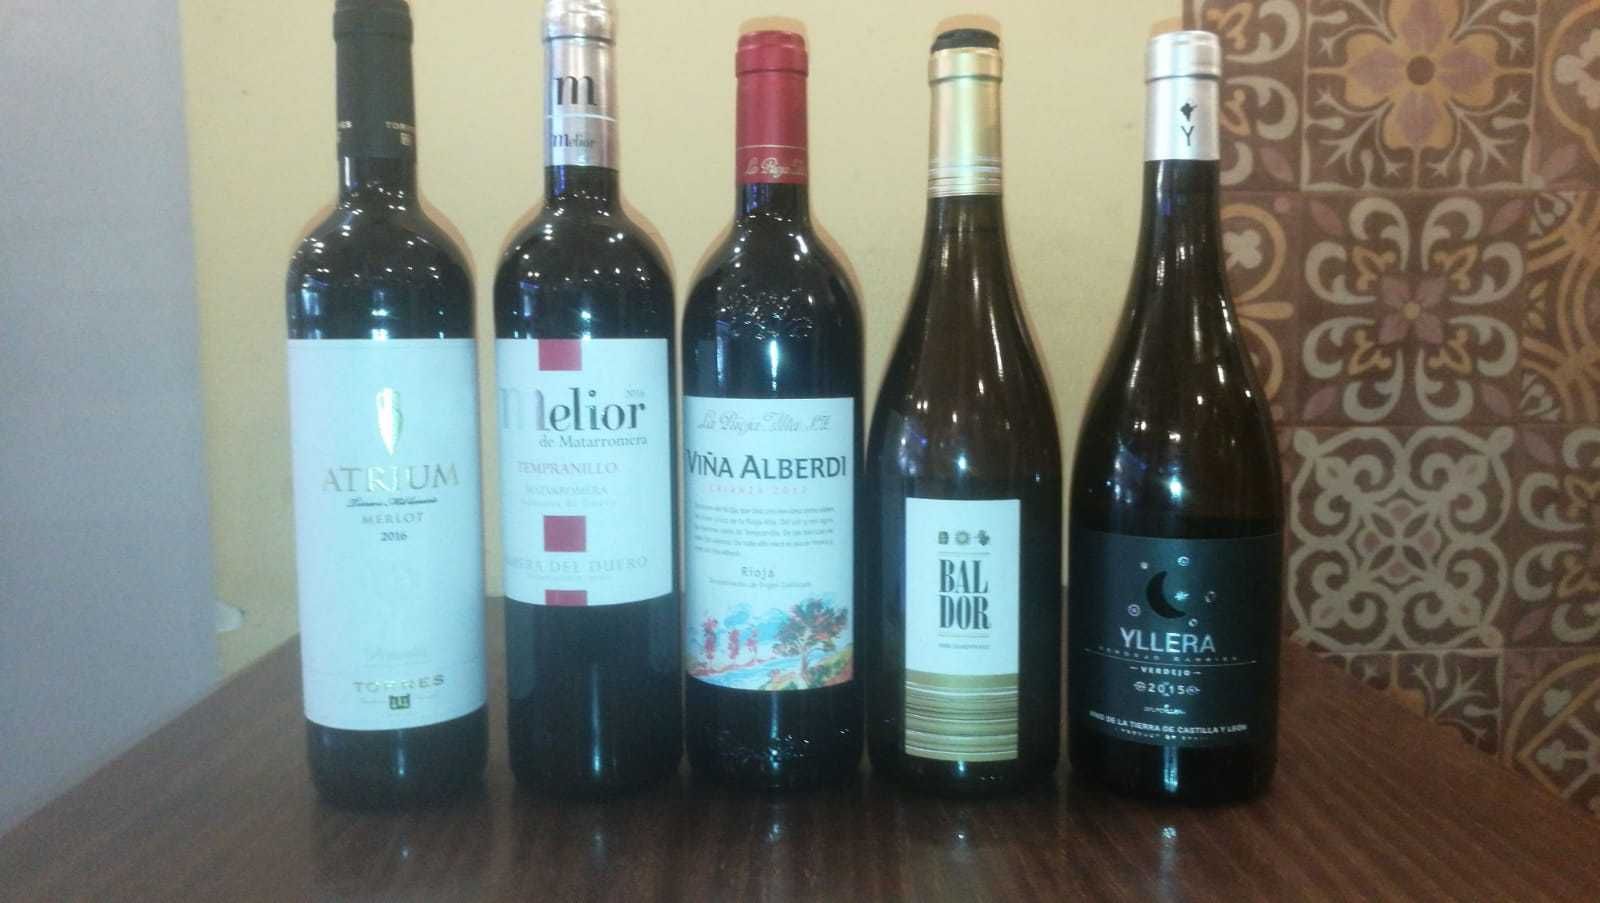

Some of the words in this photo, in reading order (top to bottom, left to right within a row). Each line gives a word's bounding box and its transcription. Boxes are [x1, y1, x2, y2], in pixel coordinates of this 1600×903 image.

[553, 75, 599, 106] m
[1180, 125, 1196, 147] Y
[538, 434, 556, 449] de
[559, 434, 648, 449] Matarromera
[517, 460, 619, 475] TEMPRANILLO
[684, 449, 735, 479] VIÑA
[739, 453, 847, 480] ALBERDI
[320, 463, 462, 493] ATRIUM
[360, 511, 424, 525] MERLOT
[379, 530, 408, 543] 2016
[548, 559, 583, 574] DEL
[588, 554, 649, 573] DUERO
[938, 558, 990, 594] BAL
[938, 594, 992, 631] DOR
[1119, 626, 1217, 654] YLLERA
[1140, 666, 1191, 677] VERDEJO
[352, 672, 446, 694] TORRES
[1147, 682, 1186, 695] 2015
[1105, 715, 1117, 725] DE
[1117, 718, 1129, 727] LA
[1129, 719, 1160, 732] TIERRA
[1162, 723, 1175, 733] DE
[1177, 724, 1218, 734] CASTILLA
[1218, 724, 1226, 734] Y
